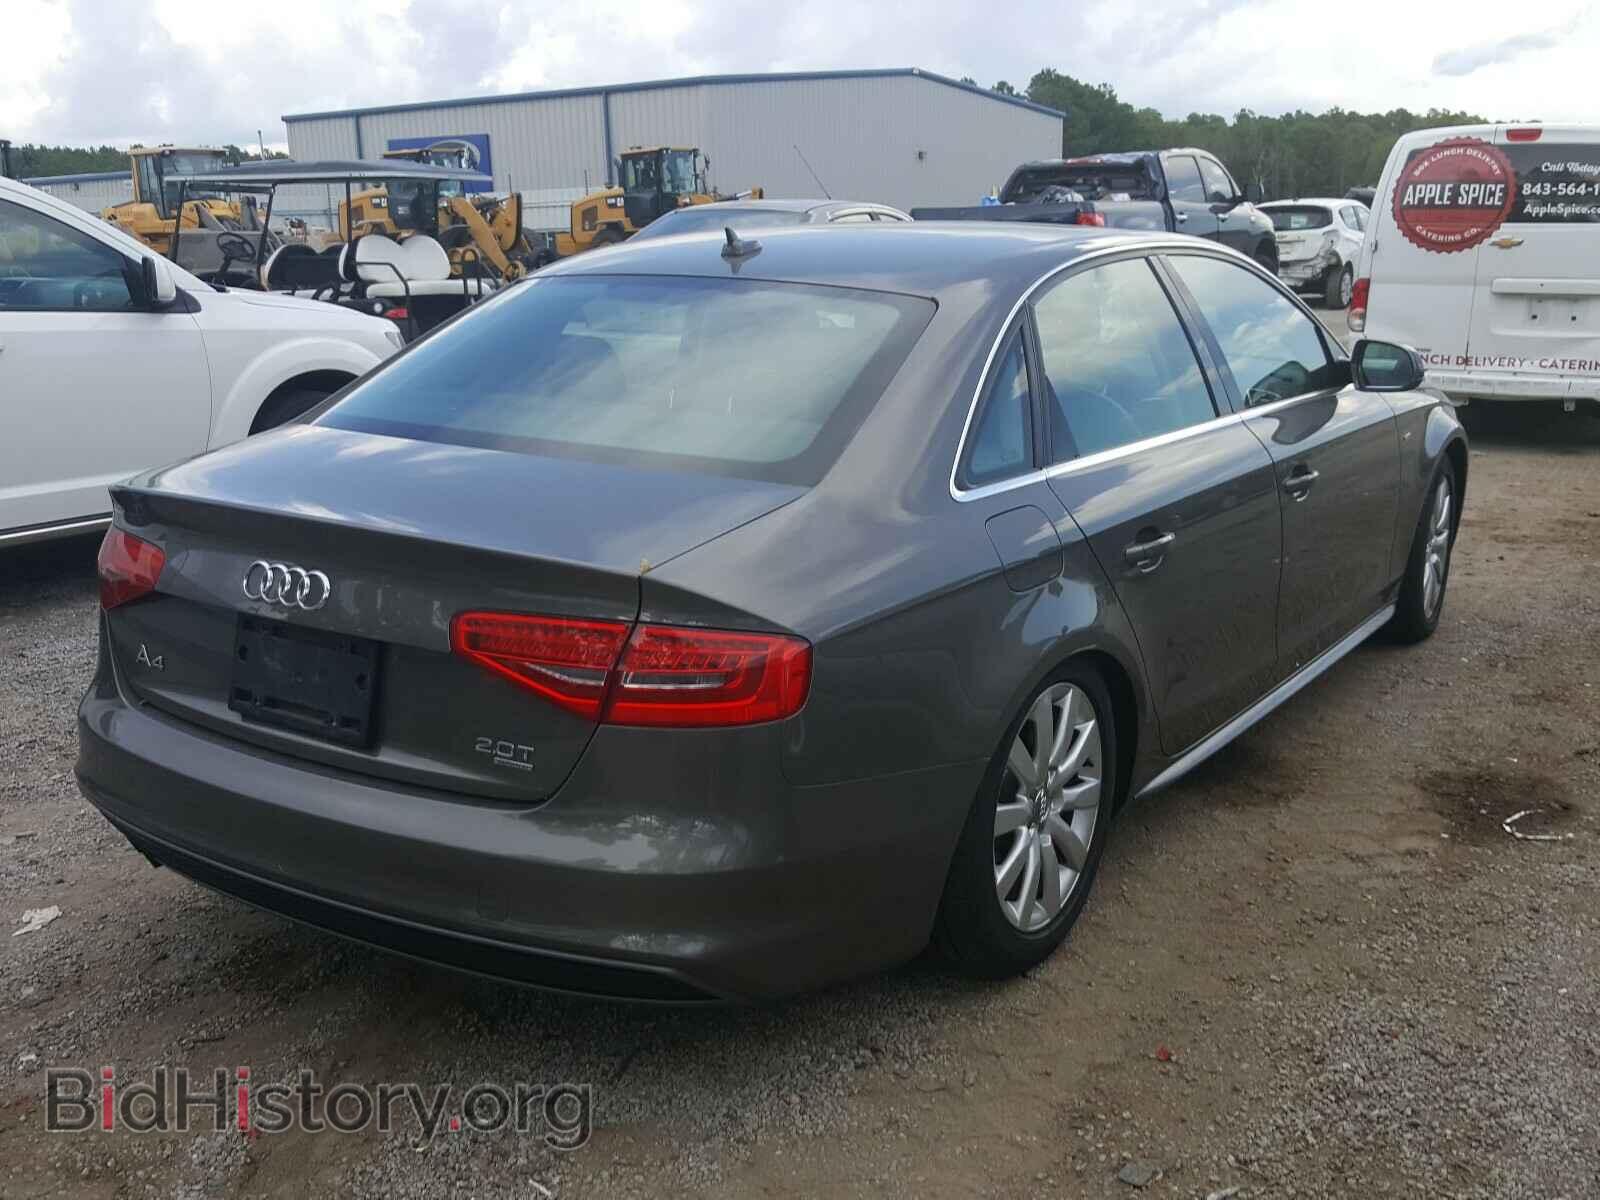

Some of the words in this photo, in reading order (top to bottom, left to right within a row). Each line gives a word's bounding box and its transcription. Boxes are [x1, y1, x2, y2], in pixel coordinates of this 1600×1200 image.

[1431, 147, 1464, 162] LUNCH
[1466, 147, 1501, 176] DELIVERY
[1541, 161, 1565, 172] Call
[1402, 183, 1453, 206] APPLE
[1458, 183, 1505, 206] SPICE
[1522, 182, 1600, 196] 843-564-1
[1415, 225, 1462, 242] CATERING
[1420, 354, 1450, 365] NCH
[1456, 355, 1526, 368] DELIVERY
[135, 644, 164, 669] A4
[475, 736, 534, 761] 2.0T
